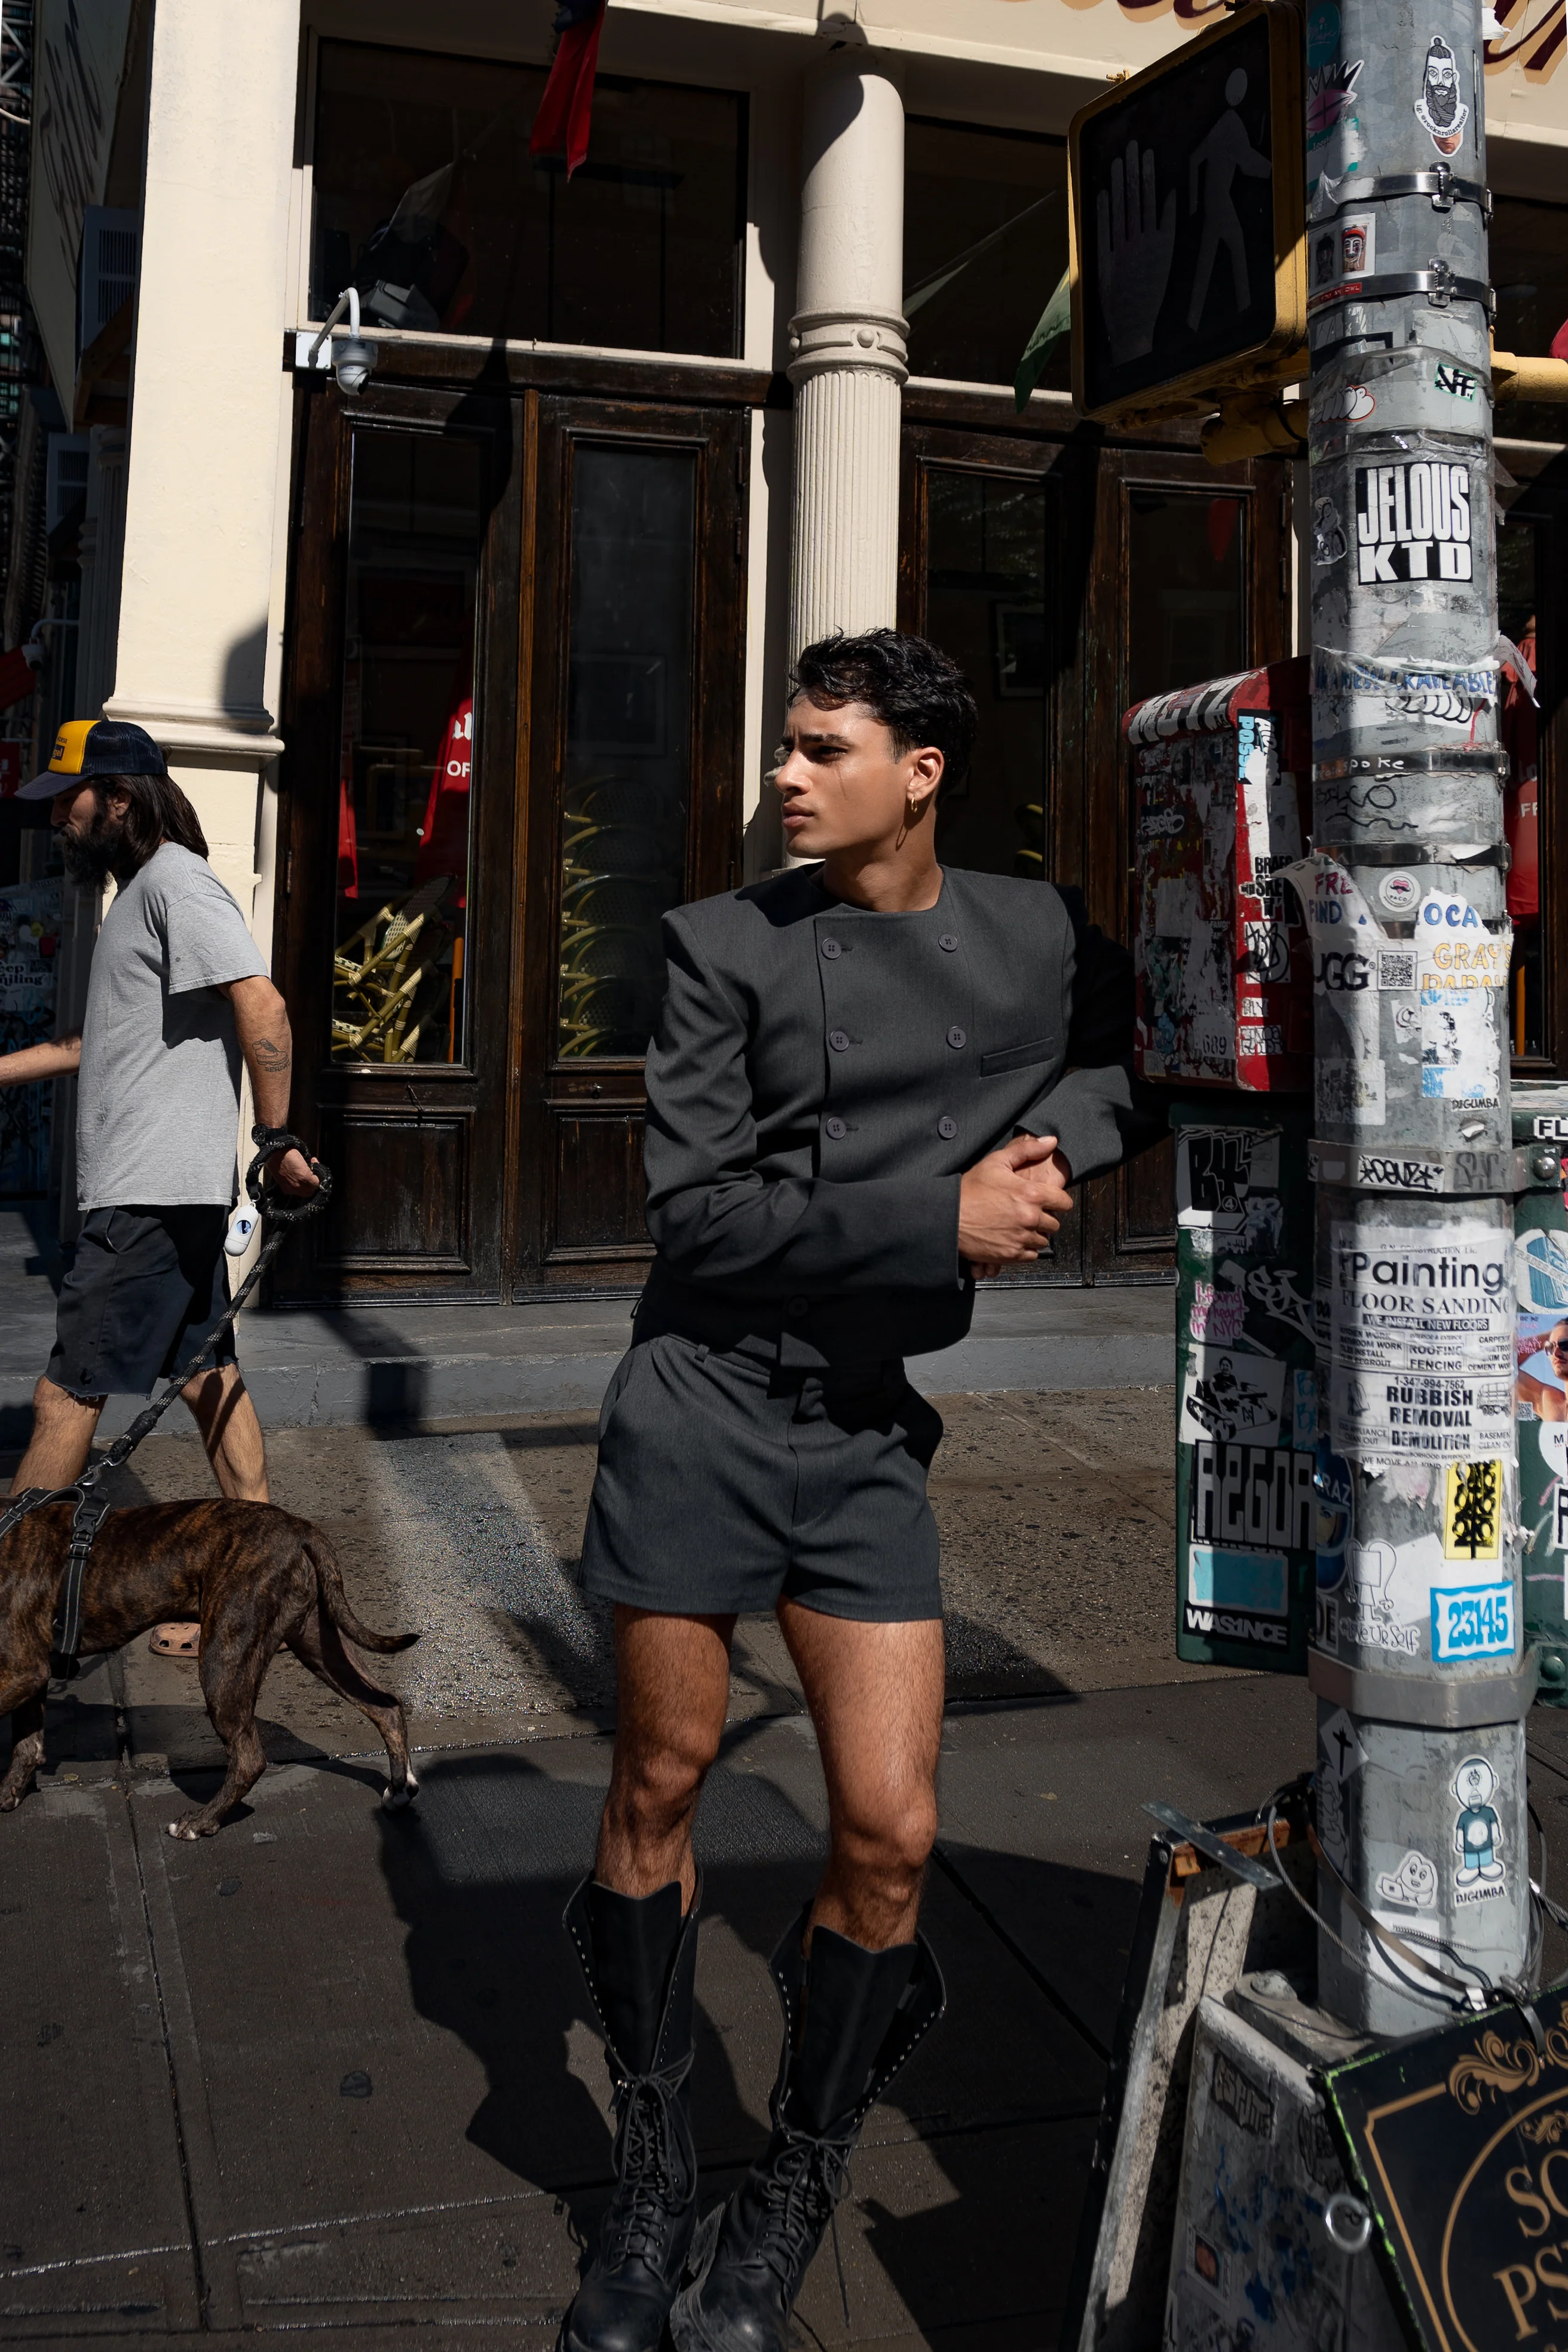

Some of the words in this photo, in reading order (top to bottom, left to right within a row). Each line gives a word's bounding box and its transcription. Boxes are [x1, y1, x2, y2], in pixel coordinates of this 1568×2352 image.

[1358, 463, 1470, 544] JELOUS
[1359, 541, 1472, 583] KTD
[1354, 1252, 1504, 1296] Painting
[1343, 1290, 1416, 1313] FLOOR
[1213, 1321, 1242, 1337] NYC
[1429, 1319, 1451, 1330] NEW
[1453, 1319, 1489, 1331] FLOORS
[1377, 1342, 1403, 1350] WORK
[1410, 1358, 1462, 1371] FENCING
[1395, 1376, 1465, 1389] 1-347-994-7562
[1387, 1386, 1474, 1406] RUBBISH
[1390, 1407, 1472, 1427] REMOVAL
[1363, 1437, 1379, 1446] OUT
[1392, 1430, 1471, 1450] DEMOLITION
[1448, 1596, 1508, 1649] 23145
[1492, 2243, 1568, 2342] PS
